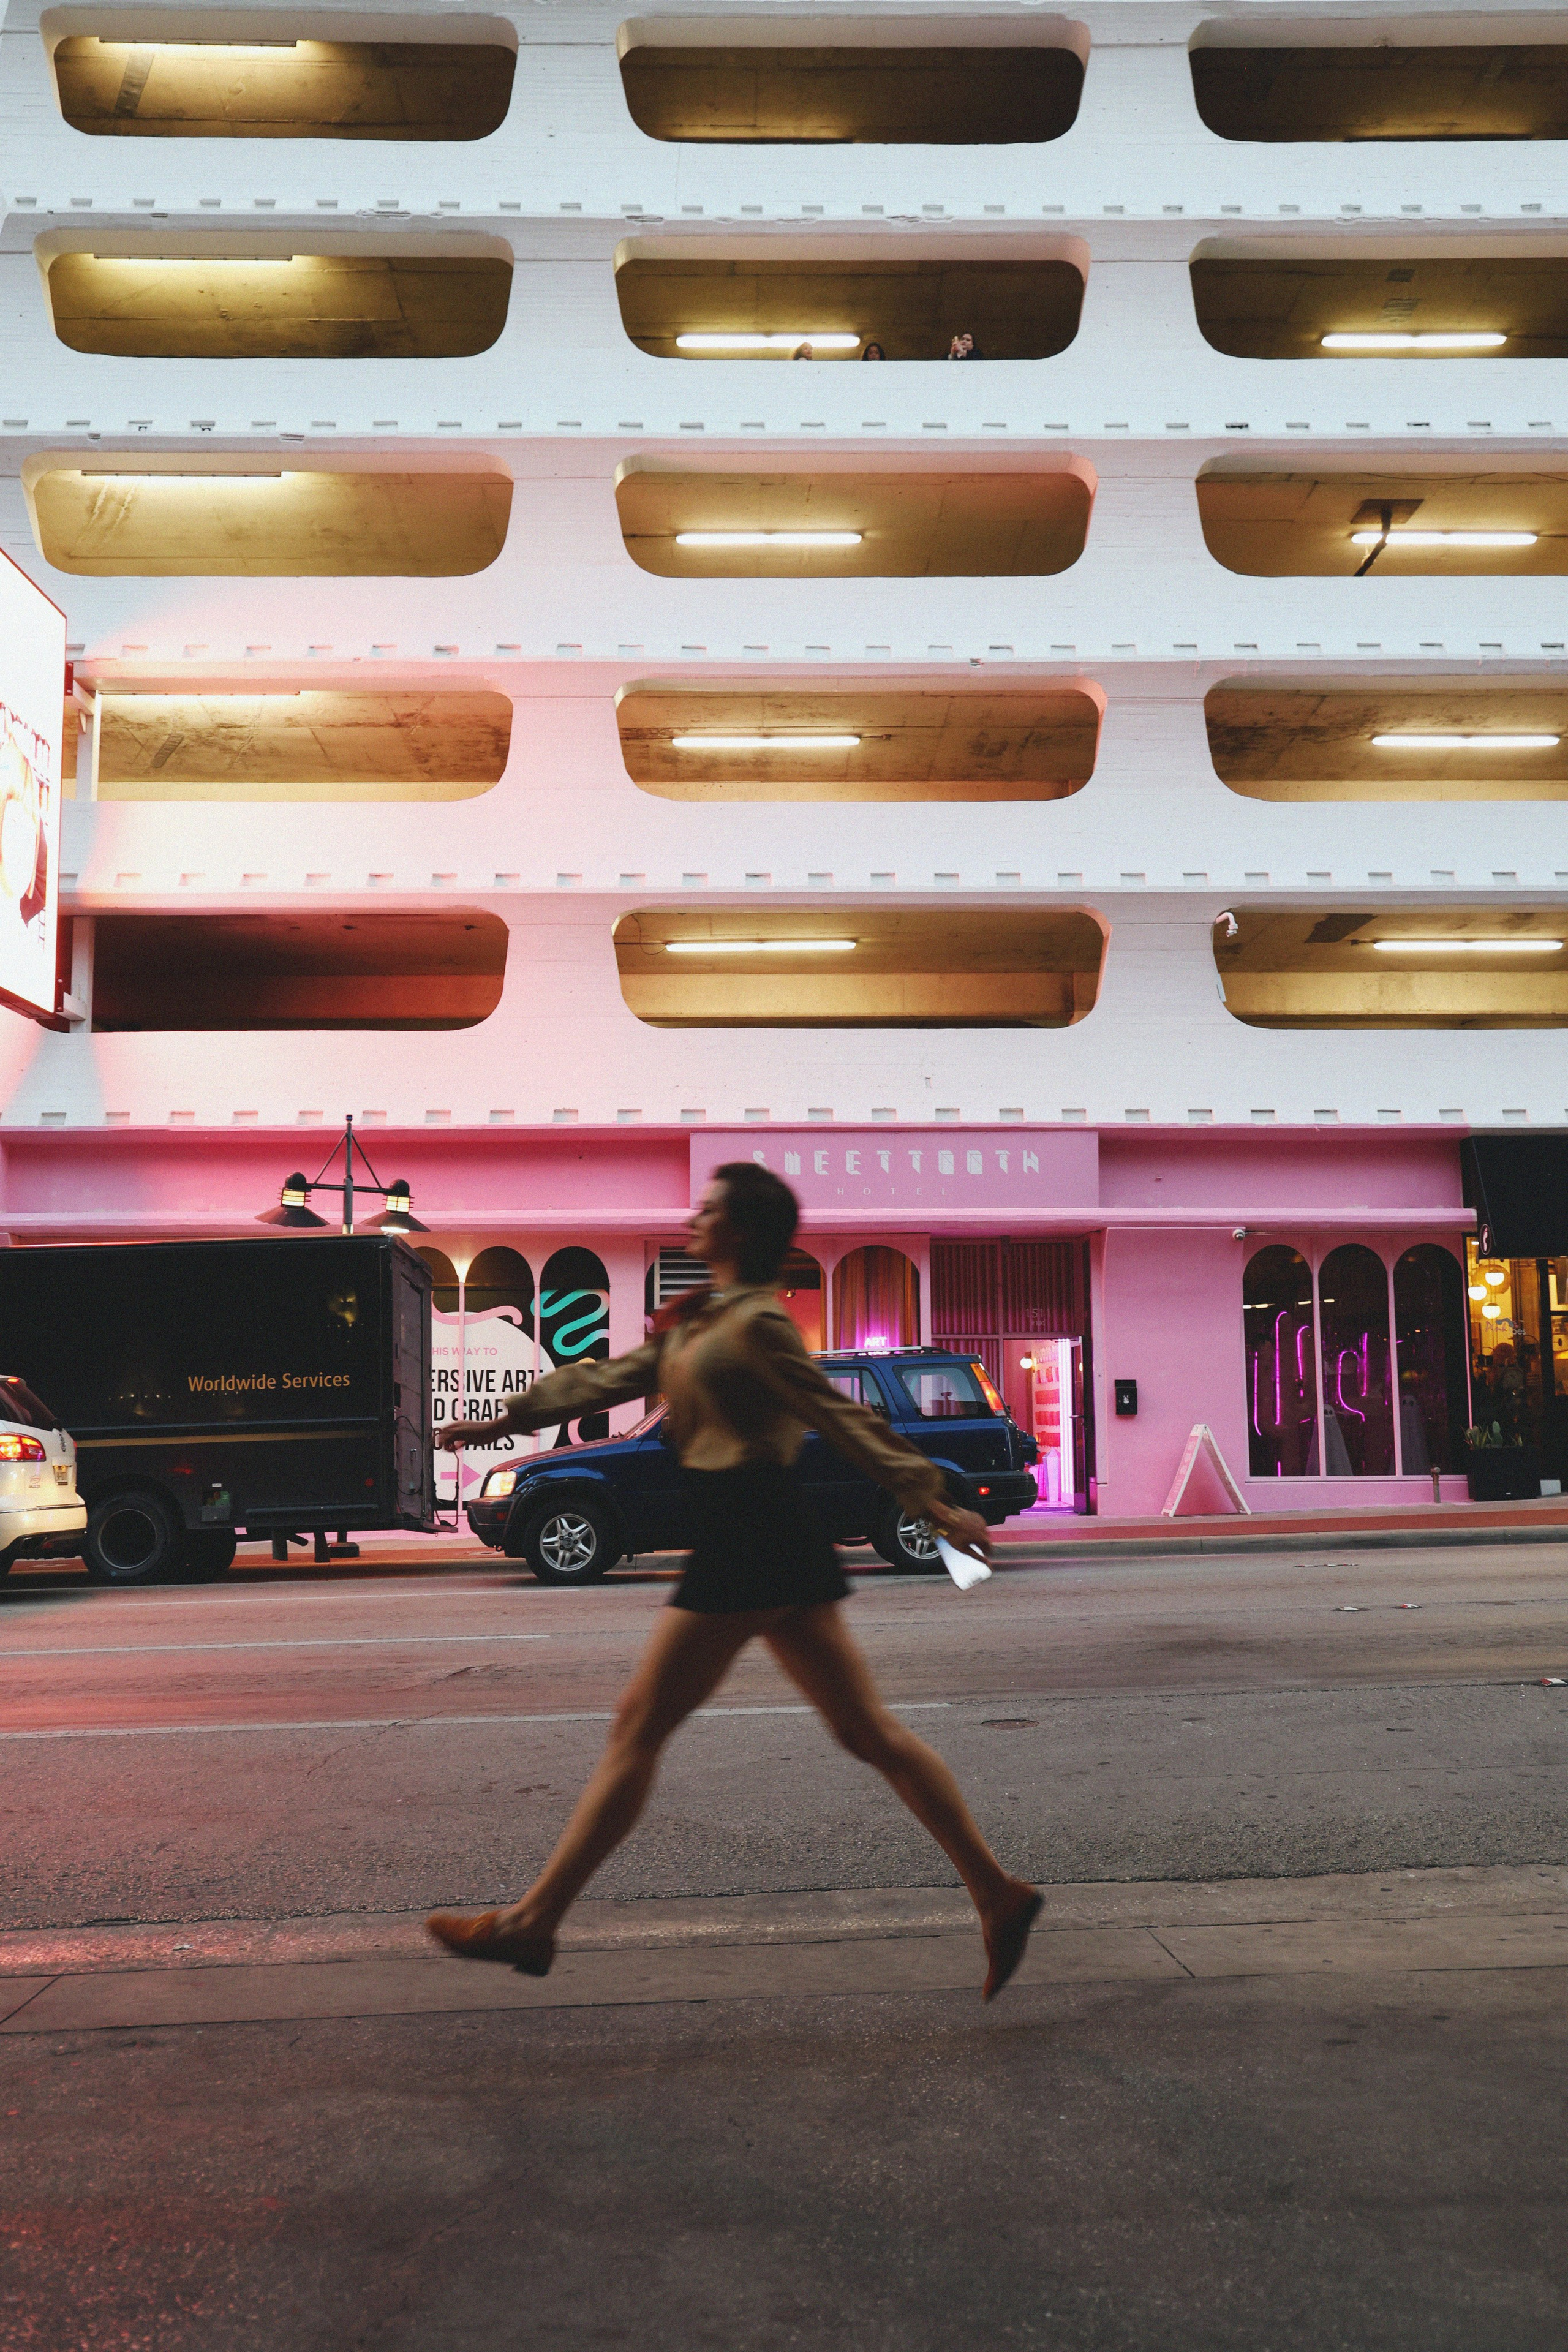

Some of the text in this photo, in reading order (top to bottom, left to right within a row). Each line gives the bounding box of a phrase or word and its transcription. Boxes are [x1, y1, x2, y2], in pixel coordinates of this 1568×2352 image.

[1025, 1308, 1050, 1318] 1511
[864, 1336, 887, 1347] ART
[187, 1371, 350, 1392] Worldwide Services
[451, 1398, 507, 1421] CRAF
